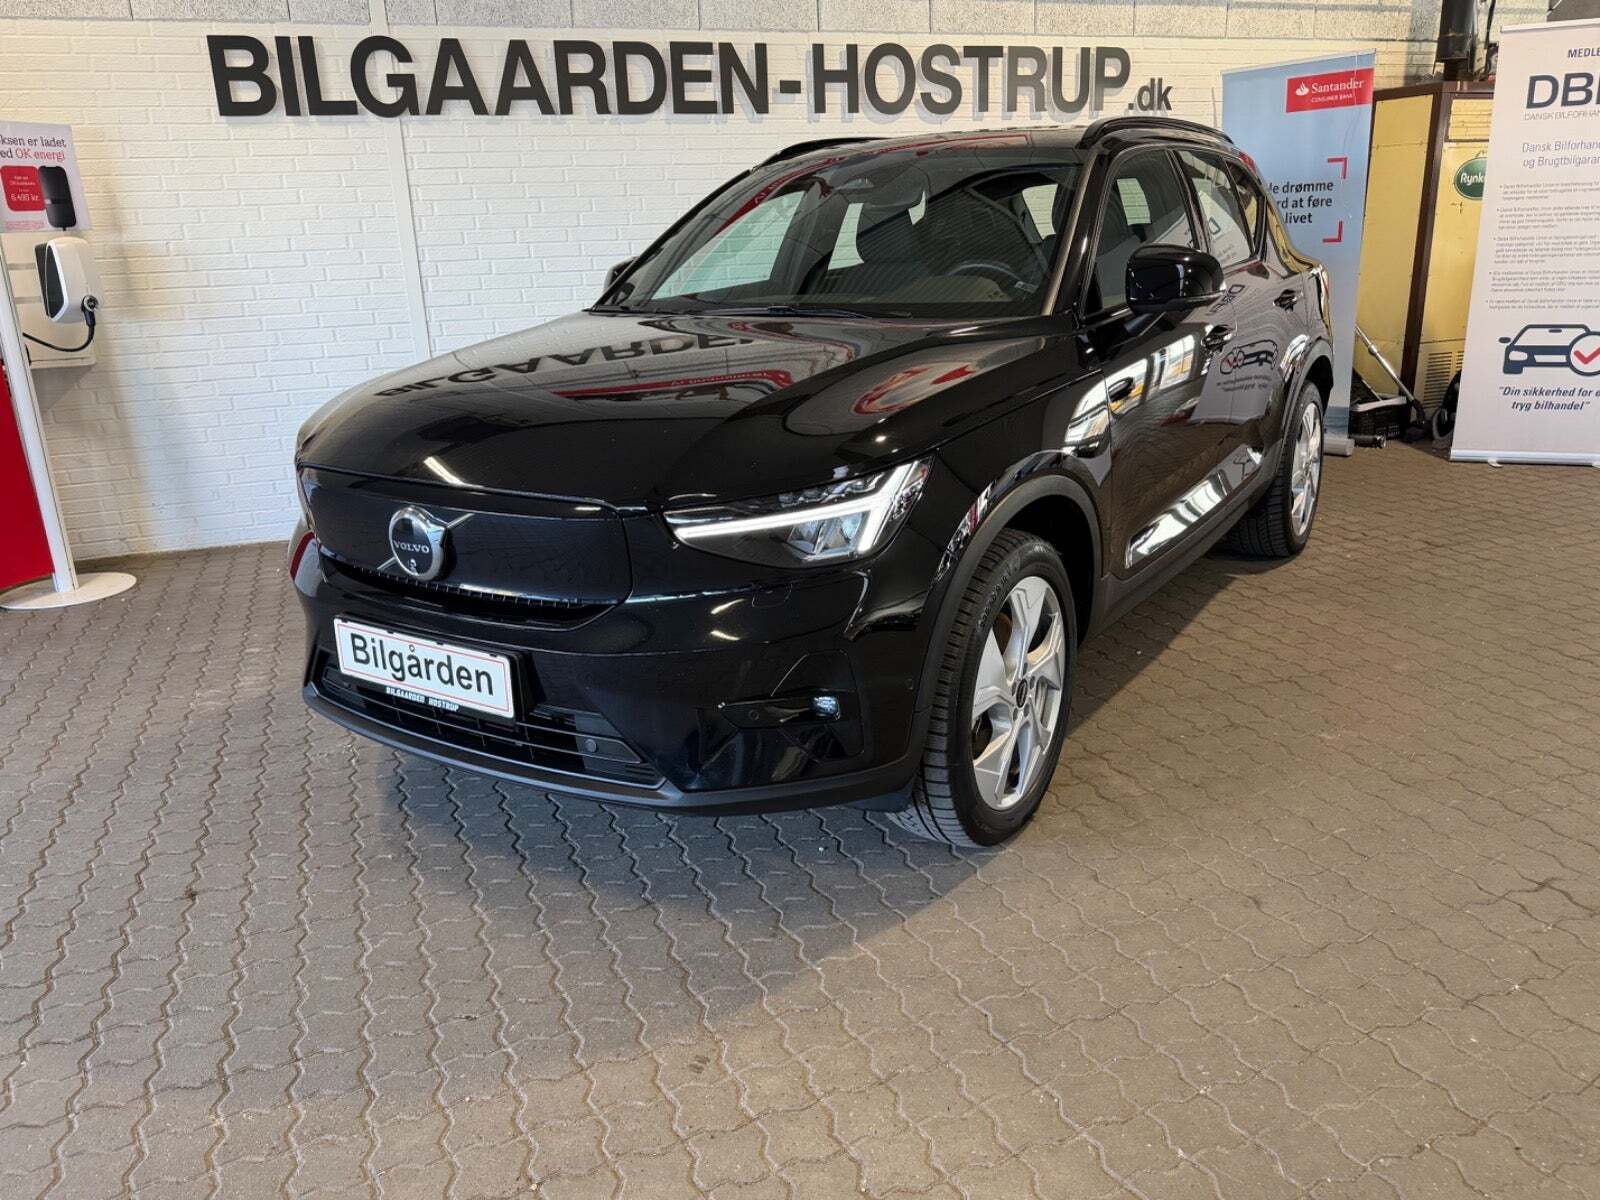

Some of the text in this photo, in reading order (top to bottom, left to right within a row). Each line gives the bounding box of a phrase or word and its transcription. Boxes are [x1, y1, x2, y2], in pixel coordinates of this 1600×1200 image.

[1311, 78, 1364, 94] Santander
[1524, 111, 1553, 121] DANSK
[28, 138, 38, 147] er
[1522, 142, 1552, 153] Dansk
[15, 147, 32, 159] OK
[34, 151, 65, 163] energi
[1522, 159, 1535, 169] og
[1282, 181, 1334, 194] drømme
[1291, 197, 1304, 208] at
[1307, 195, 1333, 207] føre
[1284, 212, 1312, 224] livet
[1523, 386, 1575, 397] sikkerhed
[1577, 387, 1593, 397] for
[1511, 401, 1532, 412] tryg
[394, 540, 430, 553] VOLVO
[350, 632, 493, 695] Bilgården
